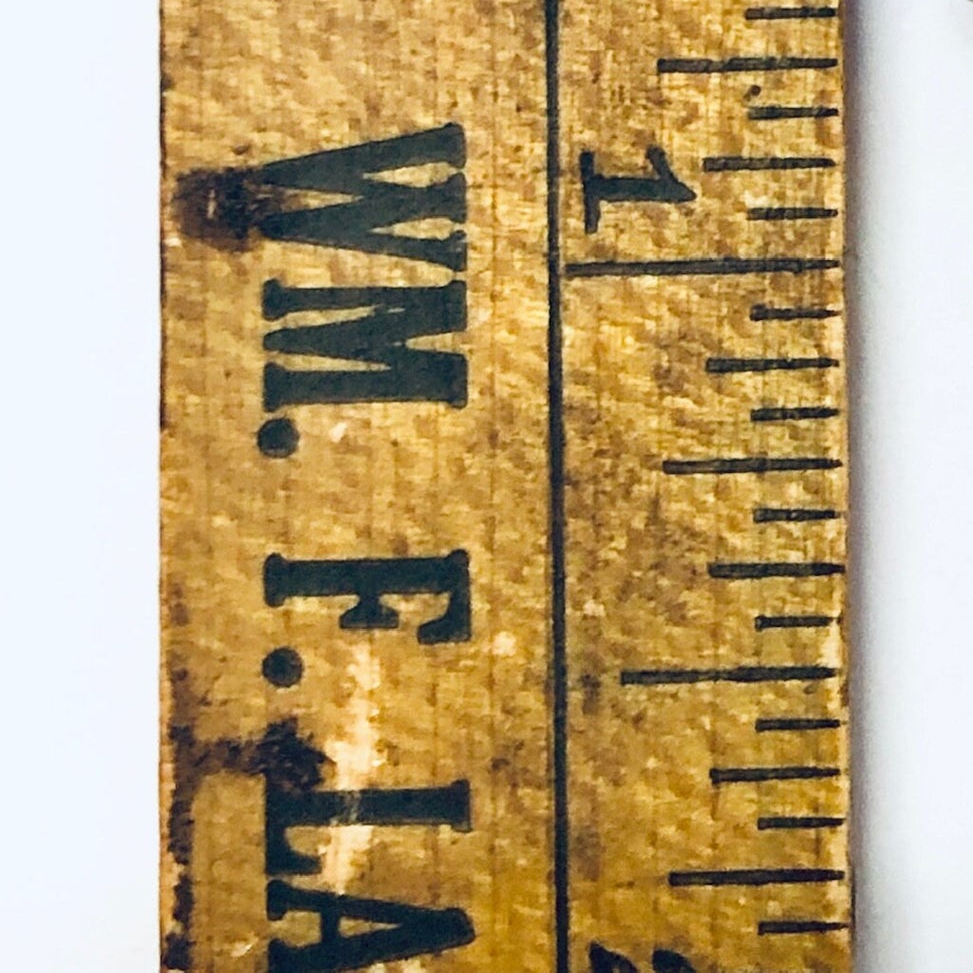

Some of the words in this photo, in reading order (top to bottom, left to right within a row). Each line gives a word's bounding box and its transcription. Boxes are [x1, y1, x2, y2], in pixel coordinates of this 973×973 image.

[579, 144, 697, 234] 1
[256, 122, 469, 459] WM.
[260, 549, 472, 689] F.
